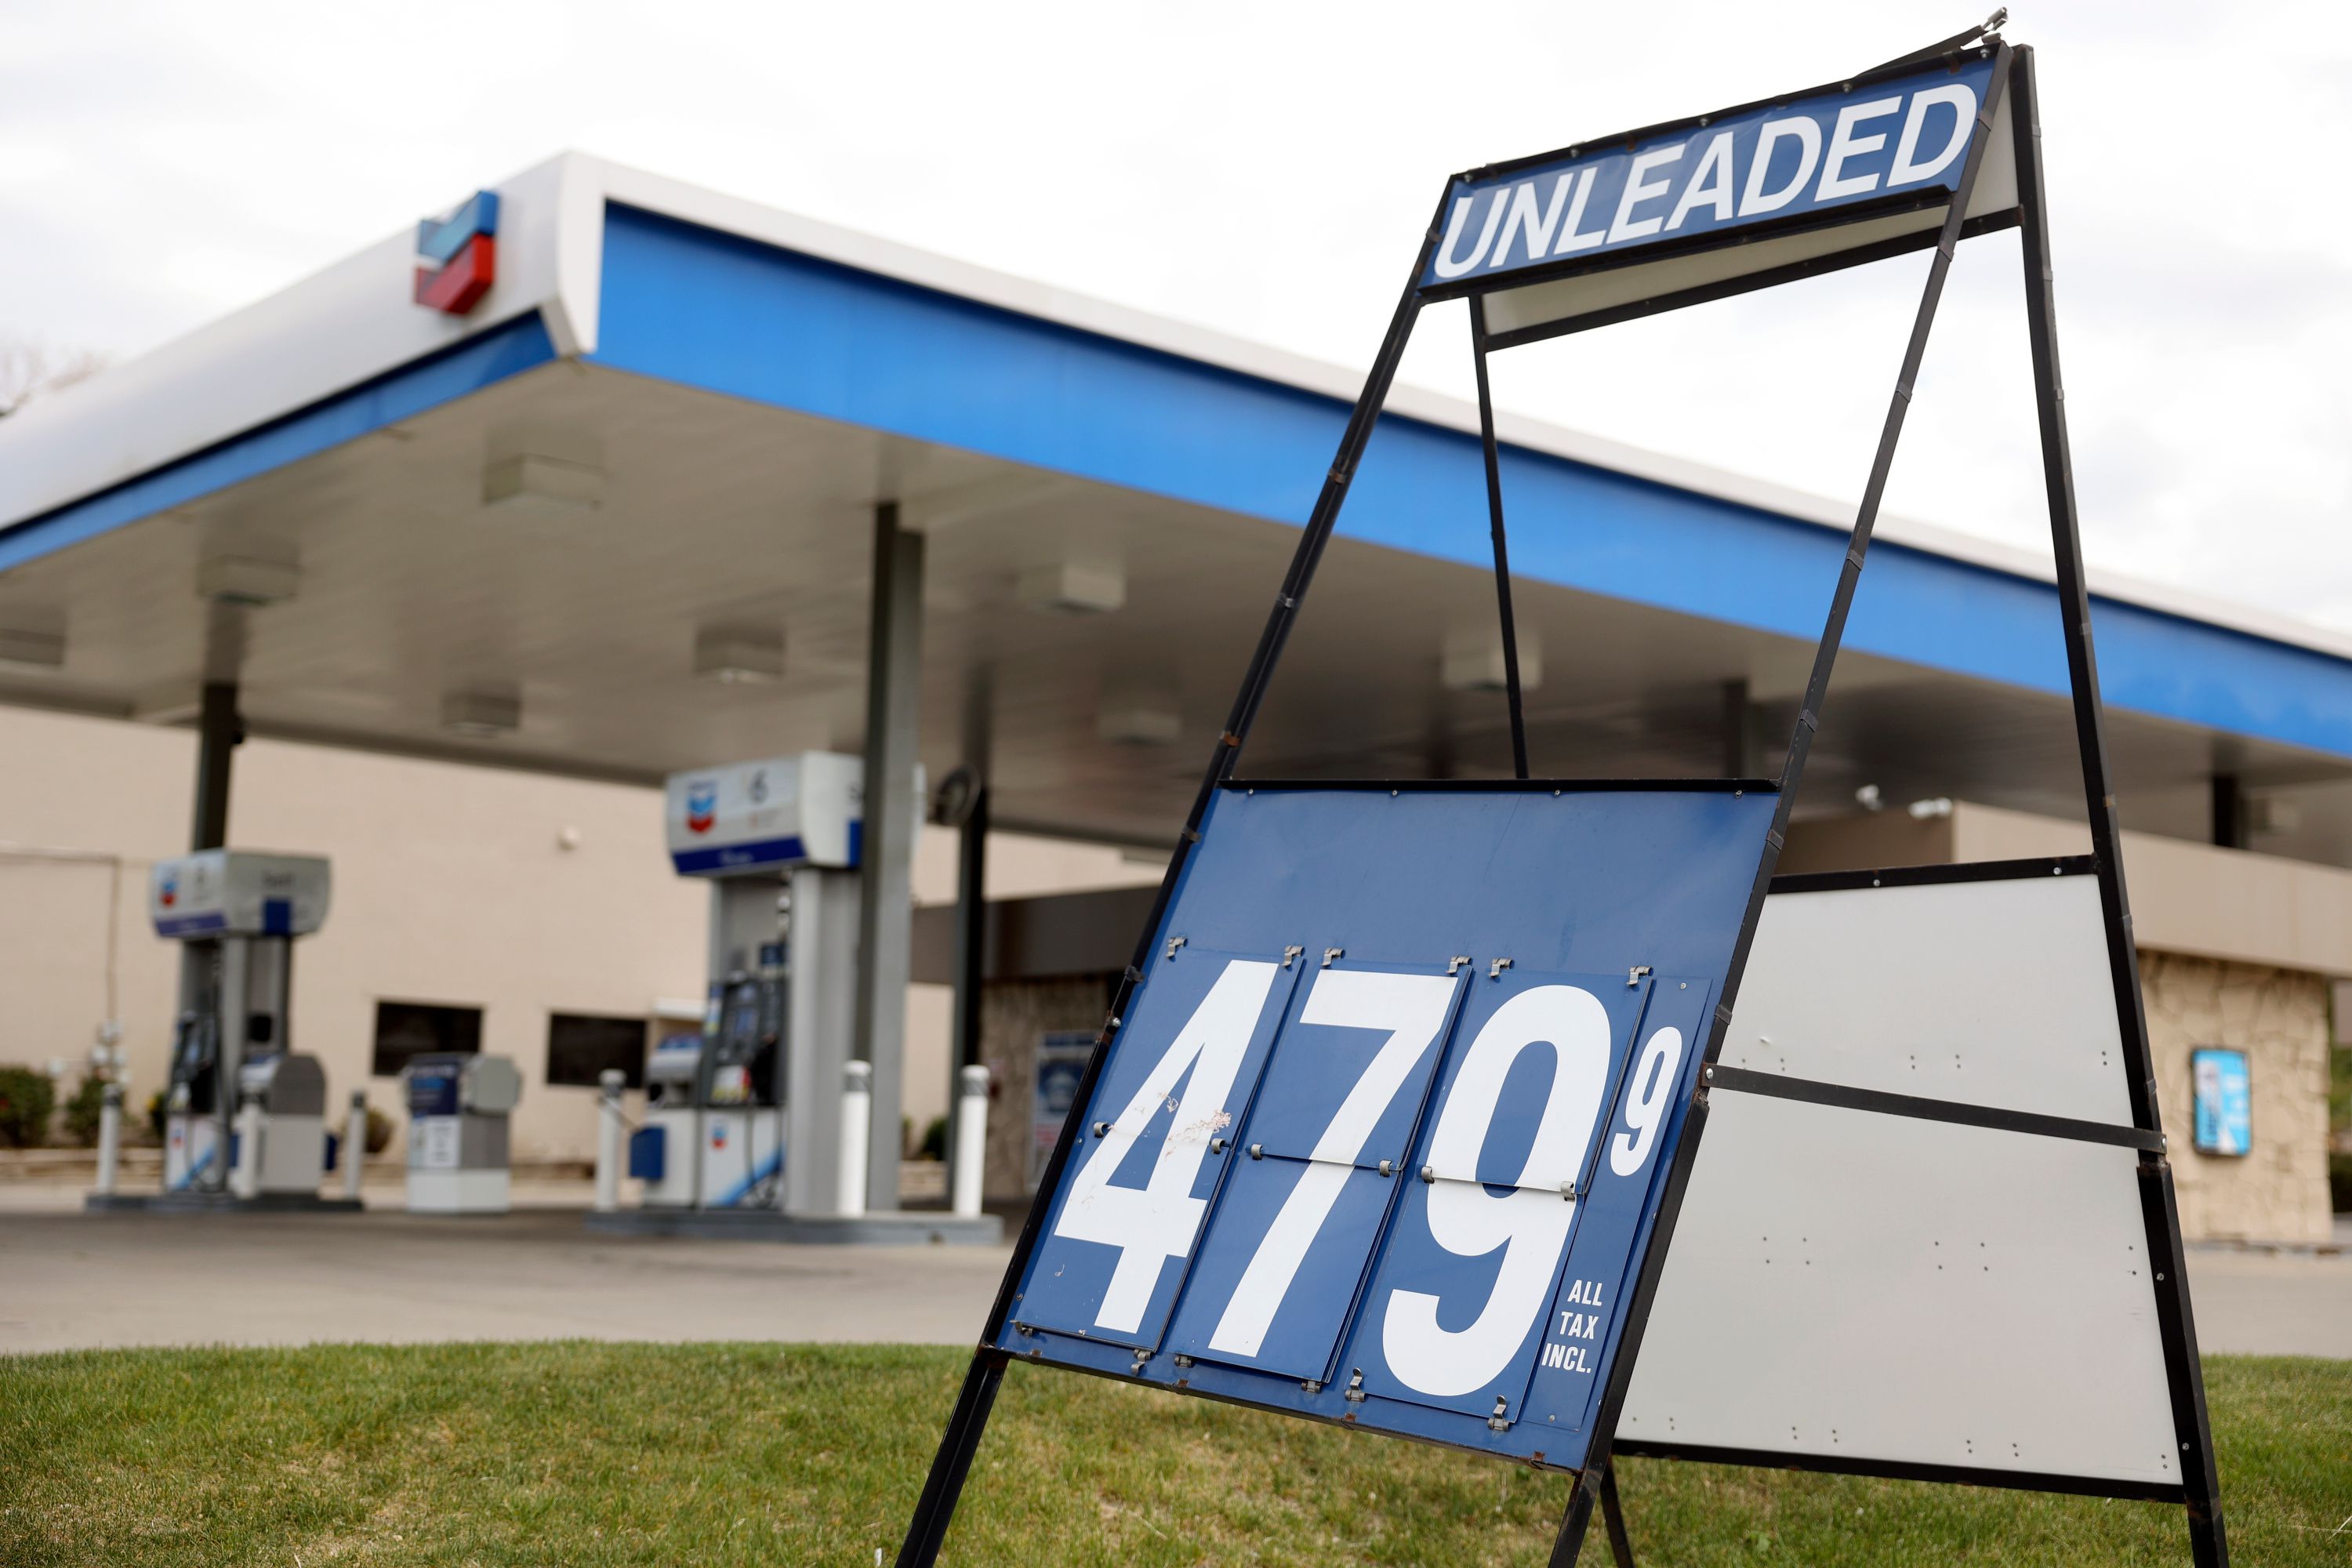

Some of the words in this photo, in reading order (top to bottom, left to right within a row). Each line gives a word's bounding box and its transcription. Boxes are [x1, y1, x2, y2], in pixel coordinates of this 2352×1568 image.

[1434, 83, 1977, 278] UNLEADED
[1567, 1279, 1602, 1306] ALL
[1559, 1311, 1599, 1339] TAX
[1541, 1343, 1592, 1374] INCL.
